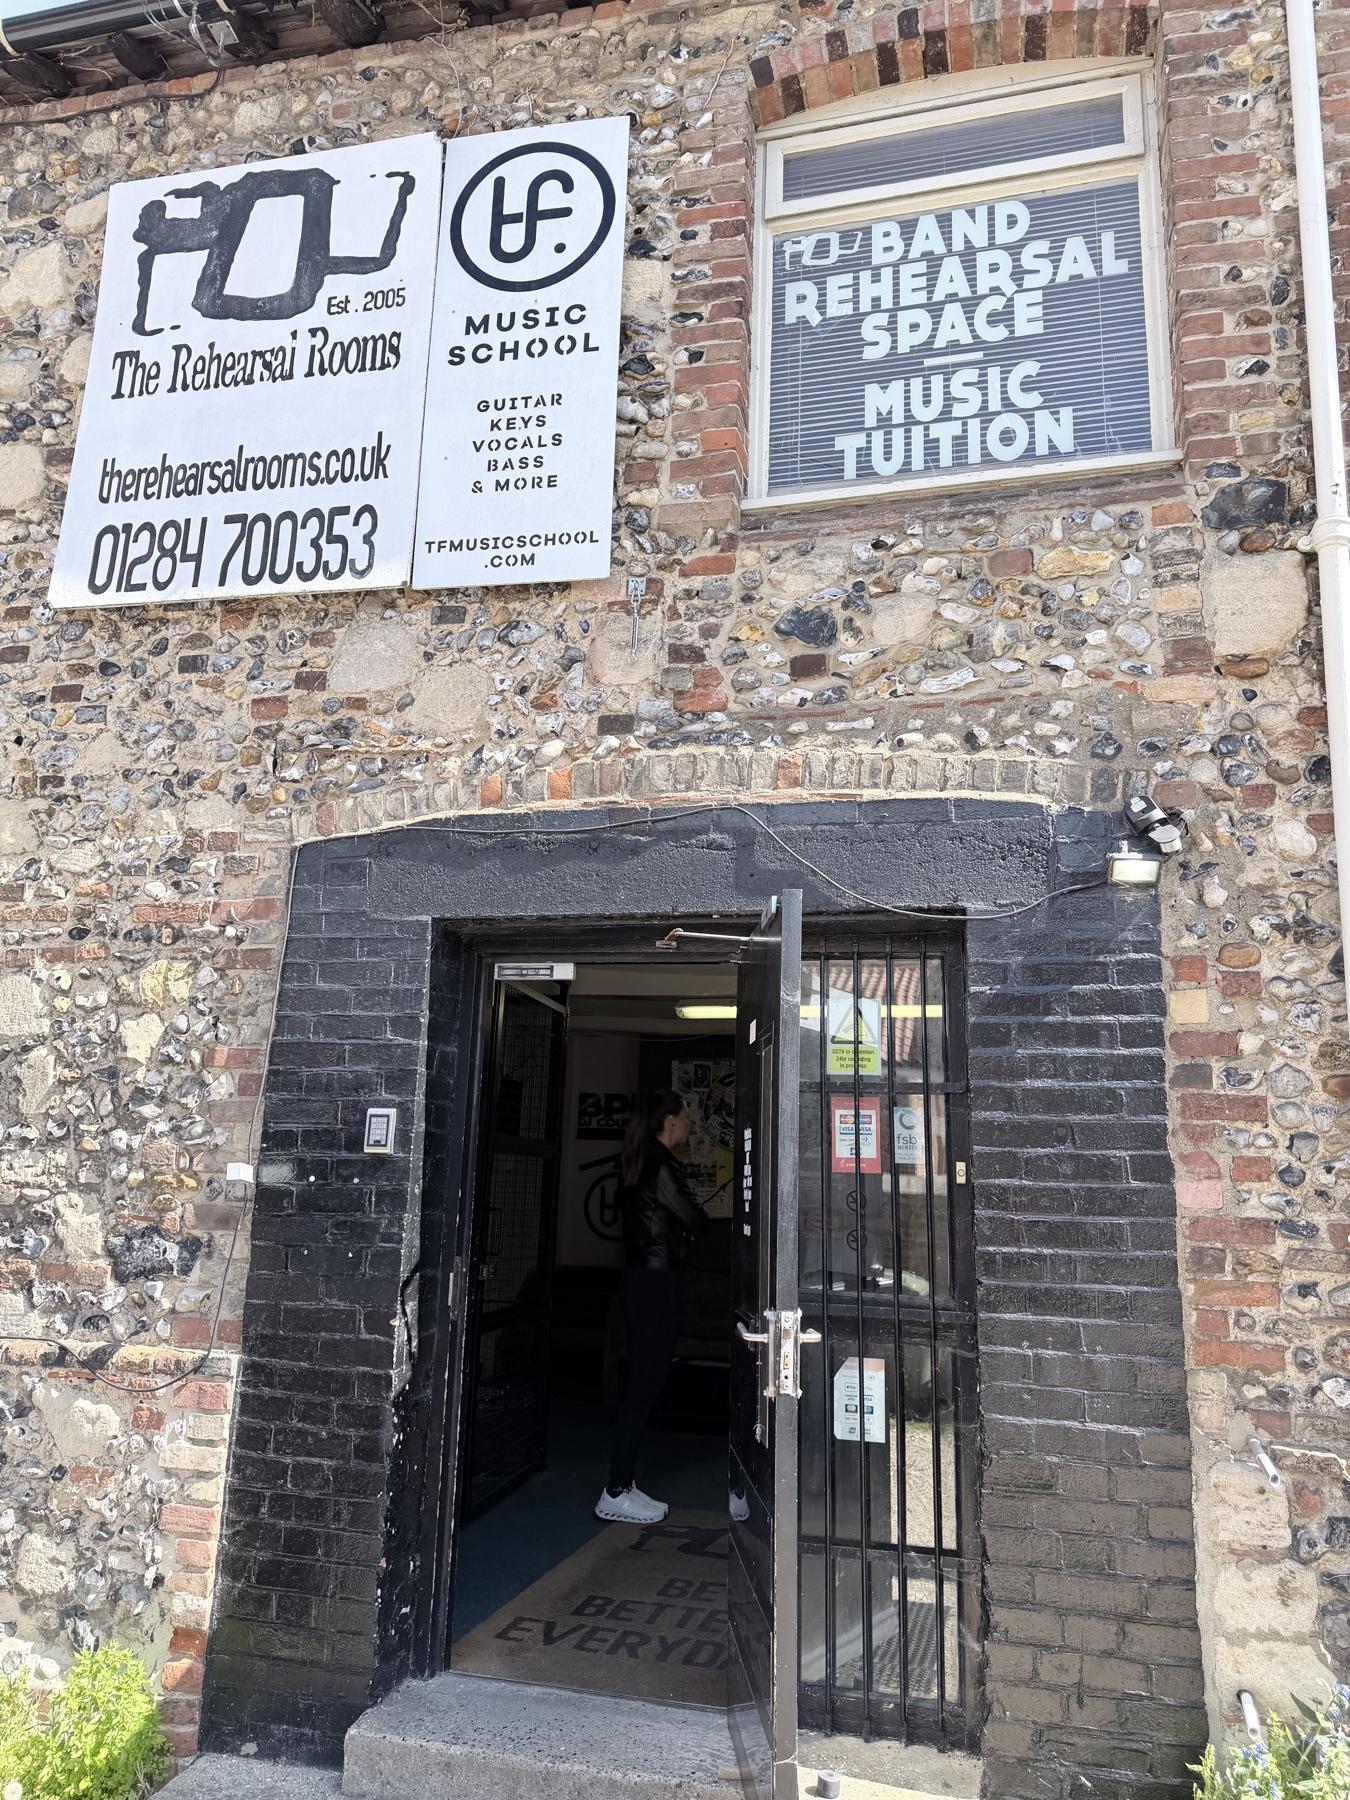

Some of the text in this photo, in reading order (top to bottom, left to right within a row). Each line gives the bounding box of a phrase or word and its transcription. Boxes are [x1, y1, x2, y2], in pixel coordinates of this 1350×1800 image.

[871, 200, 1031, 266] BAND
[784, 231, 1129, 328] REHEARSAL
[363, 288, 407, 313] 2005
[464, 303, 588, 336] MUSIC
[861, 290, 1045, 360] SPACE
[111, 326, 402, 400] The Rehearsal Rooms
[447, 332, 600, 366] SCHOOL
[476, 393, 563, 413] GUITAR
[864, 361, 1045, 428] MUSIC
[490, 415, 547, 432] KEYS
[472, 433, 563, 453] VOCALS
[835, 406, 1075, 480] TUITION
[98, 431, 391, 504] therehearsalrooms.co.uk
[487, 455, 545, 473] BASS
[471, 475, 558, 494] & MORE
[87, 504, 378, 595] 01284 700353
[425, 530, 600, 554] TFMUSICSCHOOL
[484, 553, 536, 569] .COM
[896, 1133, 918, 1145] fsb
